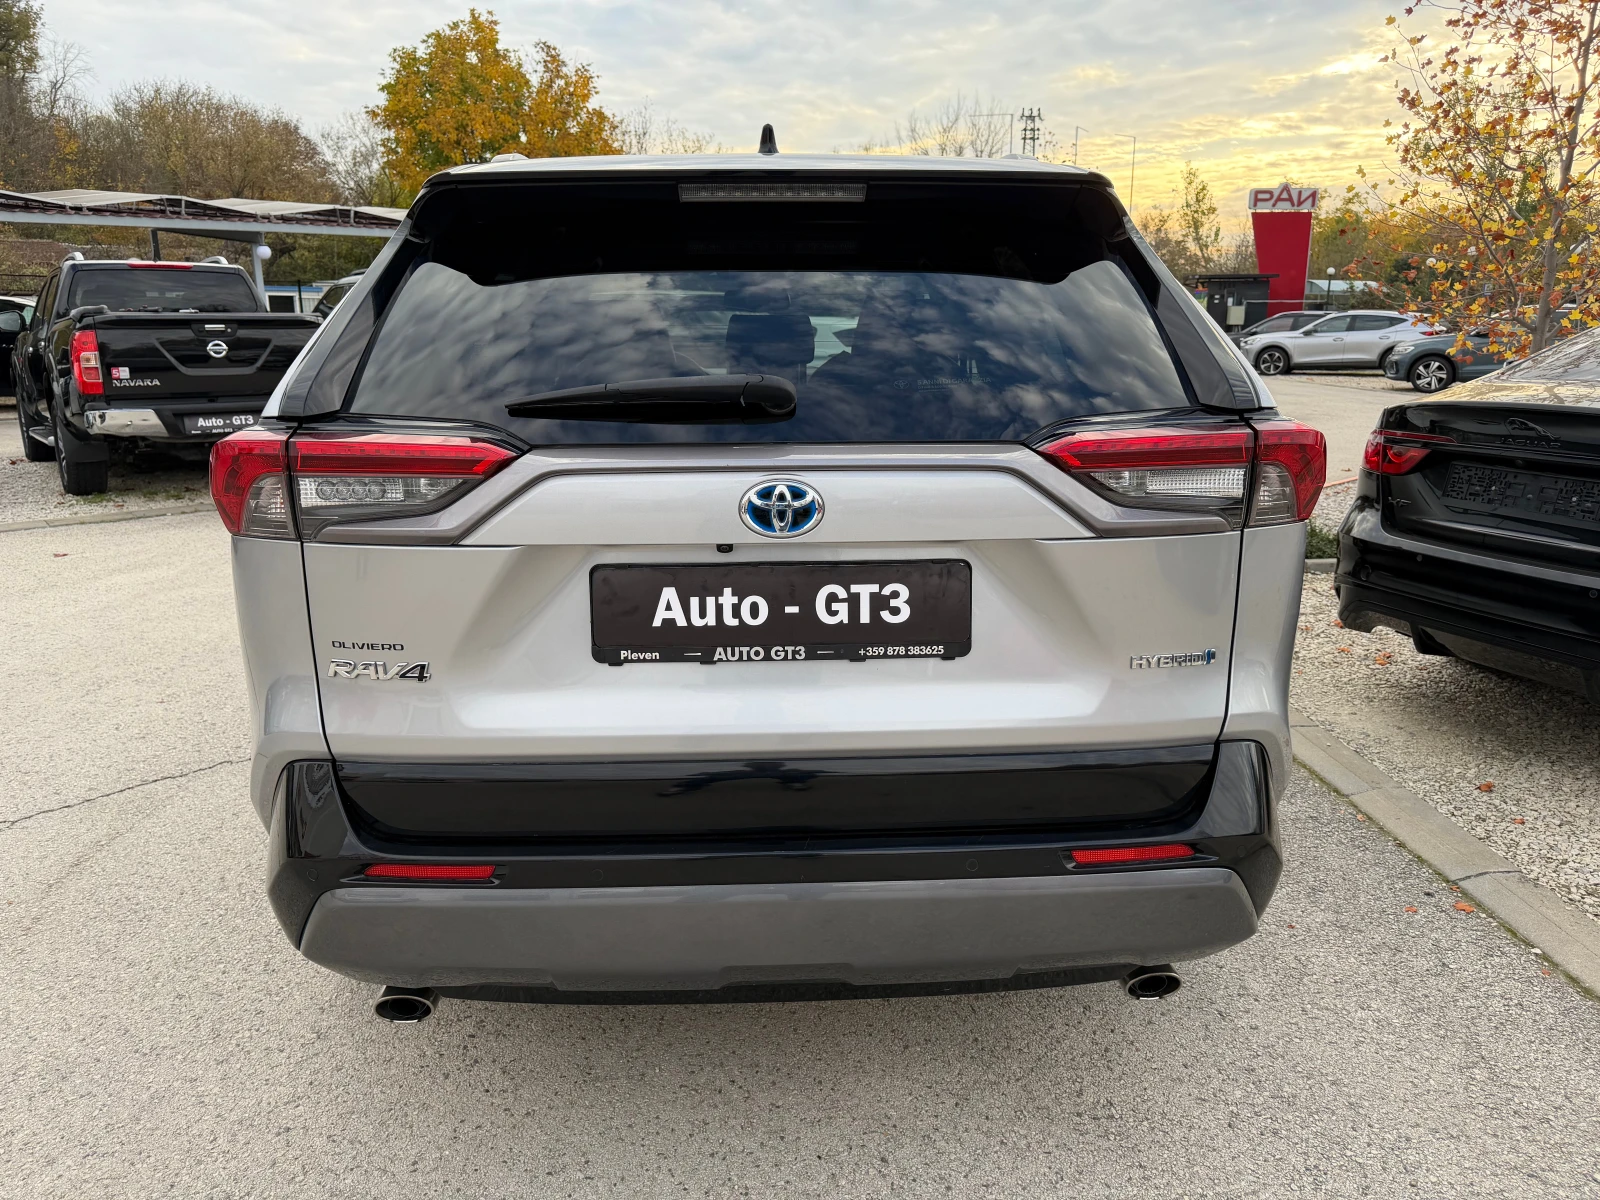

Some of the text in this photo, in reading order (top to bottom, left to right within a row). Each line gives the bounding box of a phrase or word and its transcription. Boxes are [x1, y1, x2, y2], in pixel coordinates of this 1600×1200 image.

[112, 378, 161, 387] NAVARA
[198, 417, 224, 427] Auto
[232, 415, 254, 425] GT3
[1495, 437, 1561, 449] JAGUAR
[652, 586, 769, 627] Auto
[815, 583, 911, 625] GT3
[331, 640, 405, 651] OLIVIERO
[620, 645, 945, 661] Pleven AUTO GT3 +359 878 383625
[1130, 652, 1204, 669] HYBRID
[327, 658, 432, 683] RAV4
